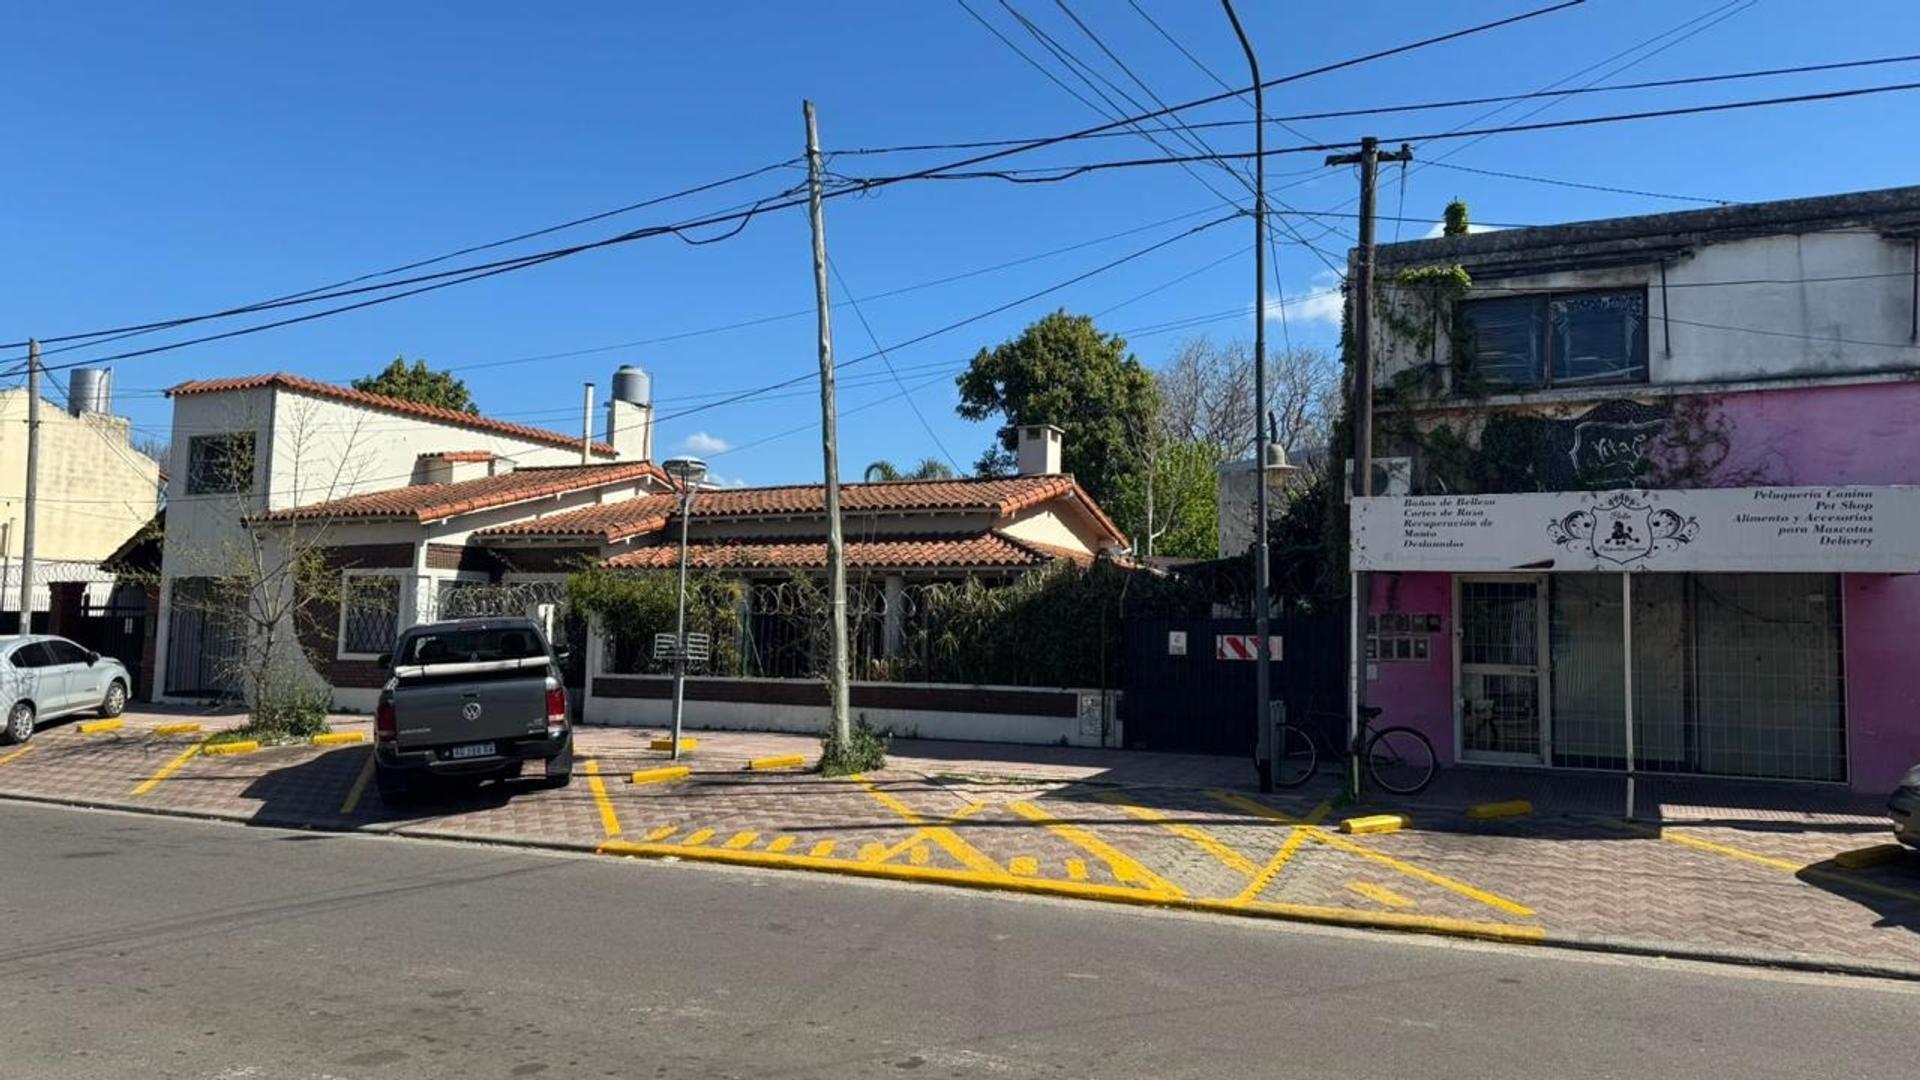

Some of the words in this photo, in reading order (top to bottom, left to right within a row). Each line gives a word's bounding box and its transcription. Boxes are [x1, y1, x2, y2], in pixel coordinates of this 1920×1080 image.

[1826, 490, 1872, 499] Canina
[1404, 498, 1436, 507] Baños
[1440, 498, 1452, 506] de
[1456, 498, 1496, 506] Belleza
[1816, 501, 1836, 510] Pet
[1840, 500, 1873, 512] Shop
[1404, 508, 1436, 517] Cortes
[1480, 518, 1494, 526] de
[1735, 514, 1789, 523] Alimento
[1806, 513, 1873, 522] Accesorios
[1404, 529, 1437, 537] Manto
[1778, 526, 1808, 536] para
[1812, 524, 1873, 534] Mascotas
[1819, 536, 1873, 548] Delivery
